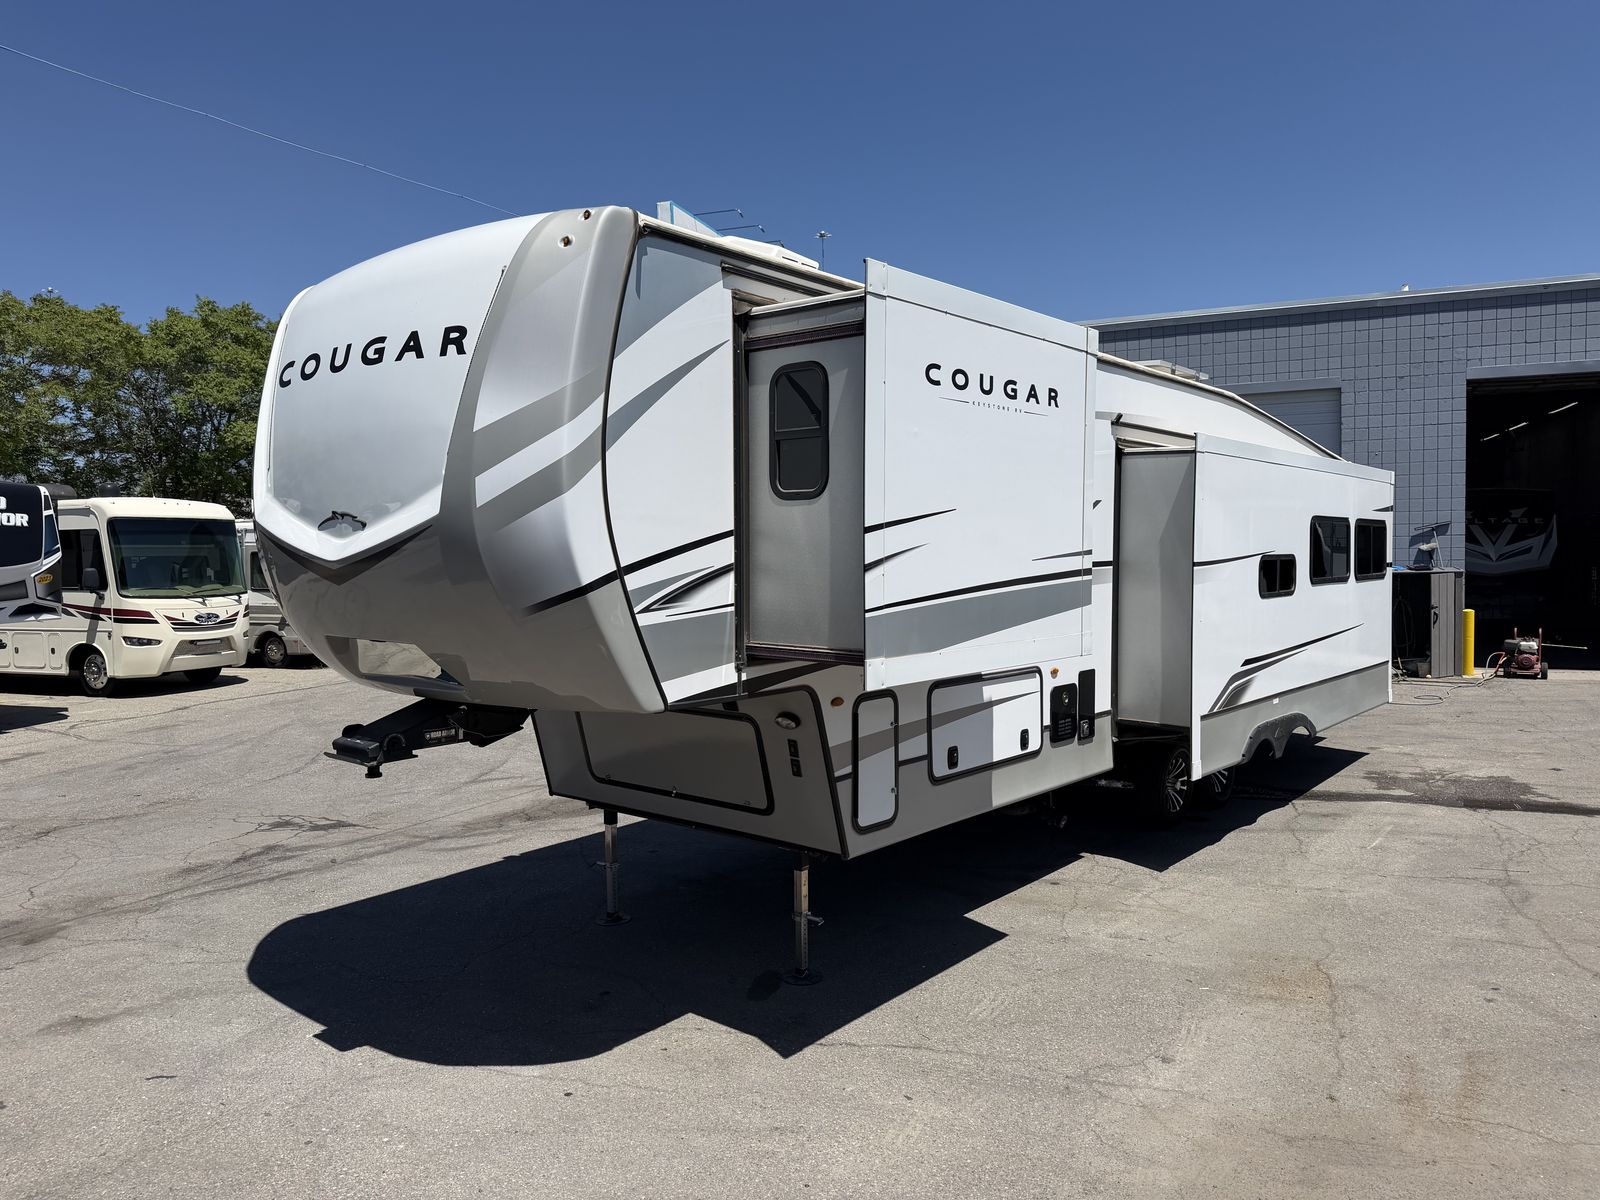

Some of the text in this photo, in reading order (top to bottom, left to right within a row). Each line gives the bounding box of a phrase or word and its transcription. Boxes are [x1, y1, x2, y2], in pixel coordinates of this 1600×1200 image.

[279, 325, 468, 389] COUGAR
[925, 363, 1060, 408] COUGAR
[0, 512, 29, 527] OR
[1465, 517, 1545, 525] LTAGE
